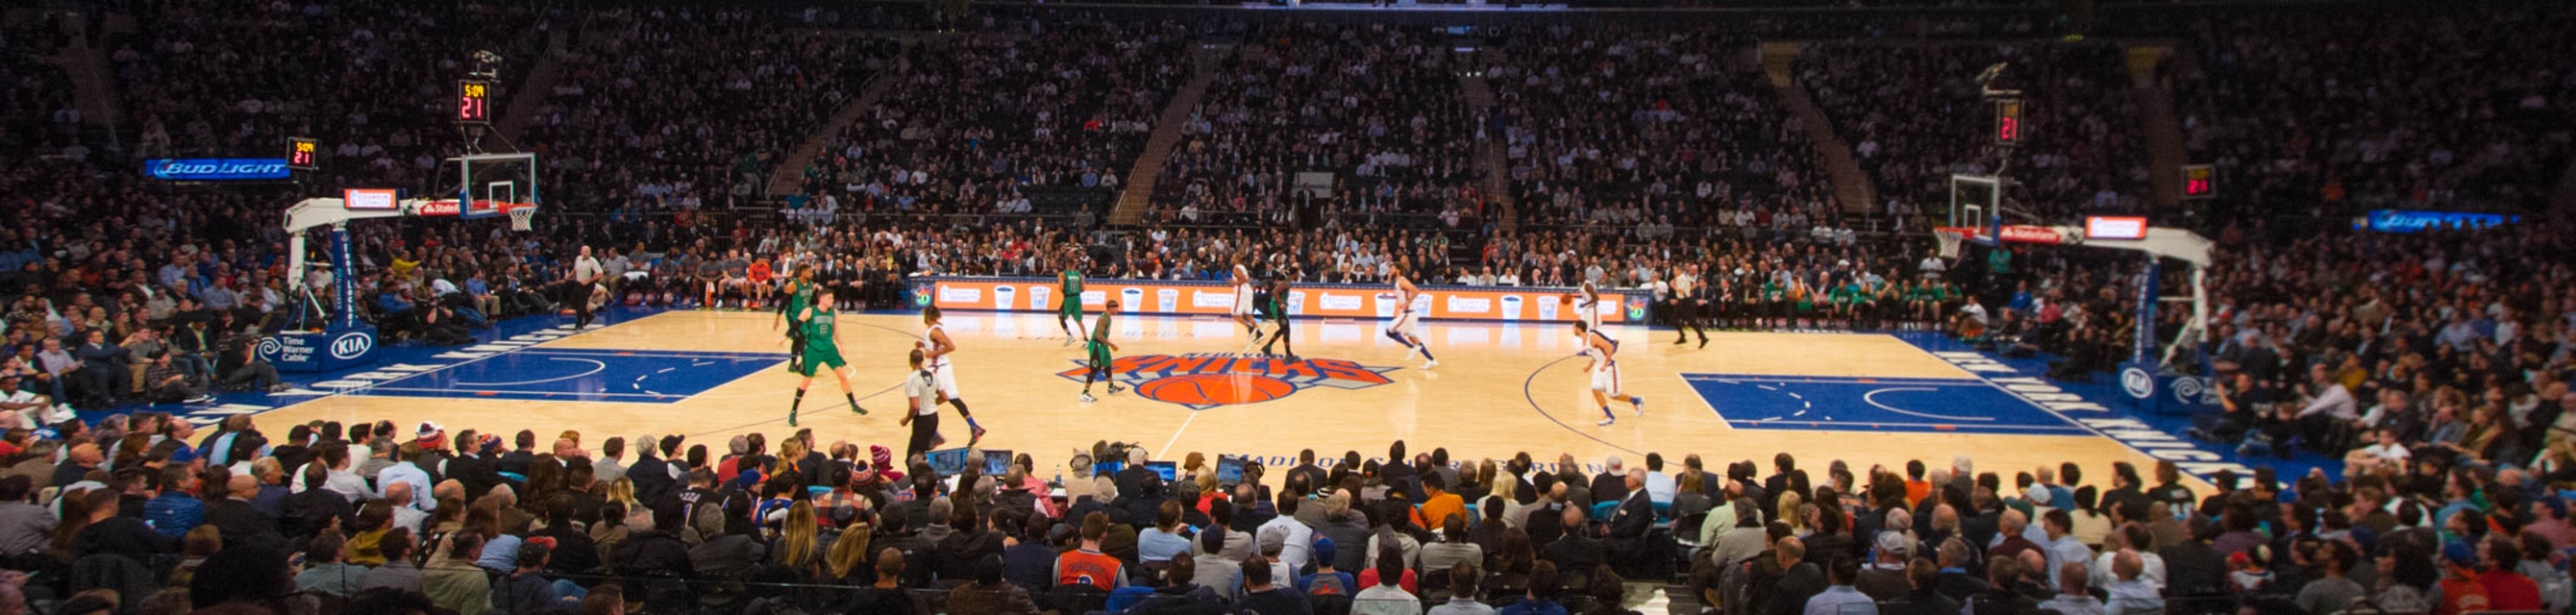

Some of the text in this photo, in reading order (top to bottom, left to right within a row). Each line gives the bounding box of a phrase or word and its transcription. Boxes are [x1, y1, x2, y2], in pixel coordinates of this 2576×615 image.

[464, 84, 484, 97] 5:09
[461, 97, 482, 118] 21
[294, 152, 310, 163] 21
[165, 163, 286, 174] BUD LIGHT
[283, 336, 305, 345] Time
[338, 337, 365, 355] KIA
[282, 354, 308, 362] Cable
[1055, 354, 1396, 386] KNICKS
